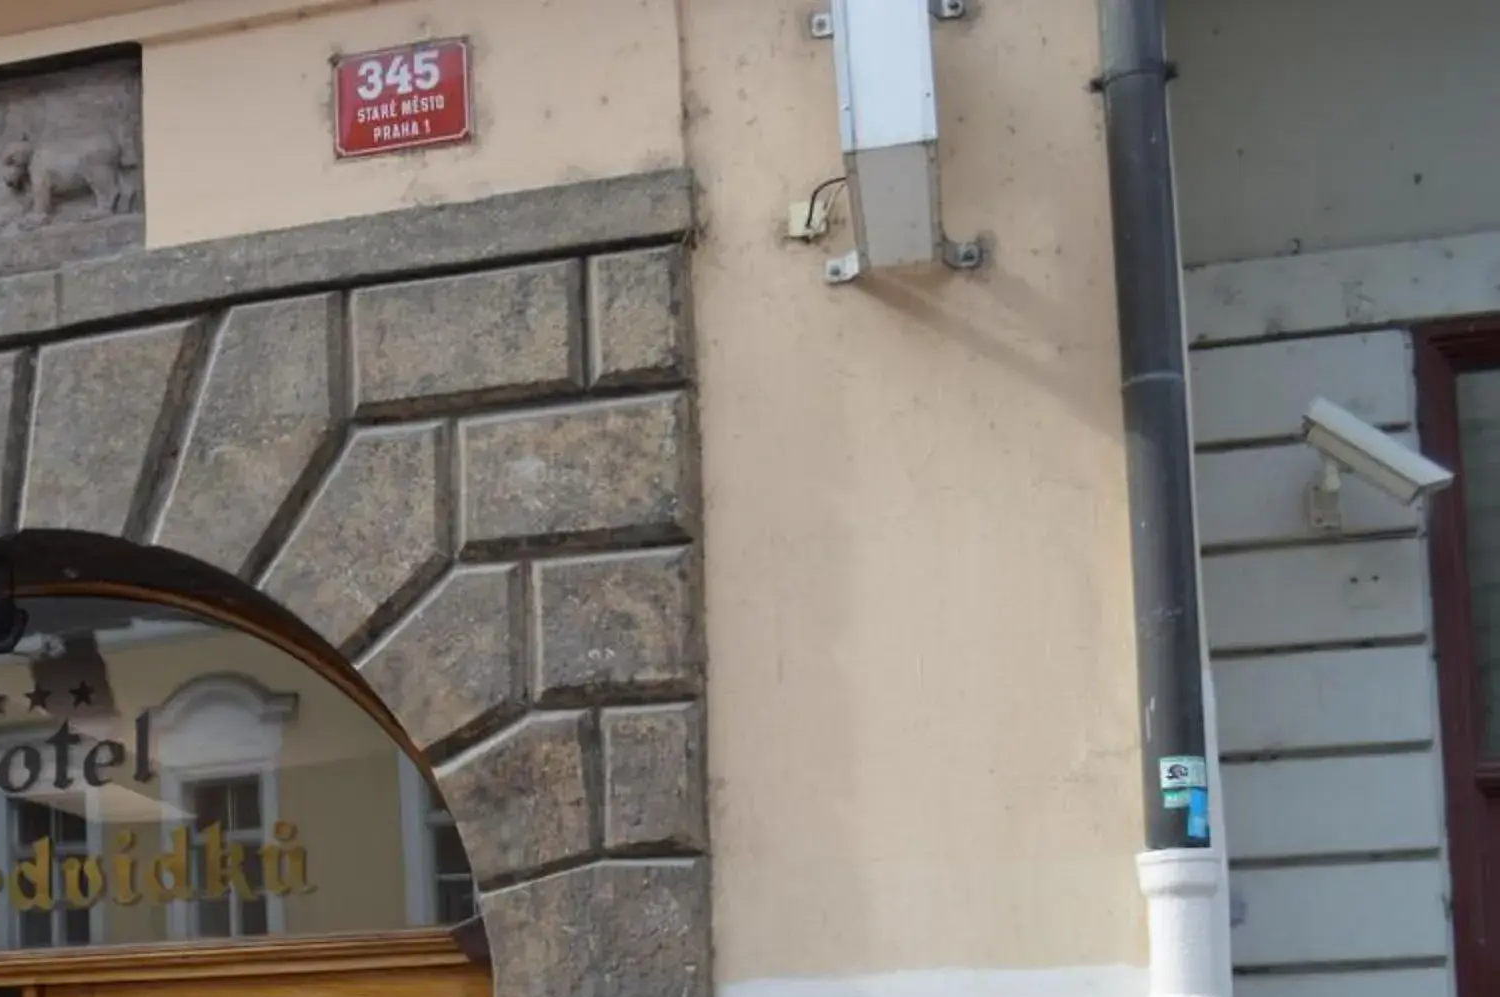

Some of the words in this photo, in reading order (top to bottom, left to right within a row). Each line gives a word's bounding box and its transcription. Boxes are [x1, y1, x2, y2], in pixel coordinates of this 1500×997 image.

[356, 49, 441, 100] 345
[357, 101, 397, 123] STARÉ
[373, 121, 419, 142] PRAHA
[424, 119, 431, 134] 1
